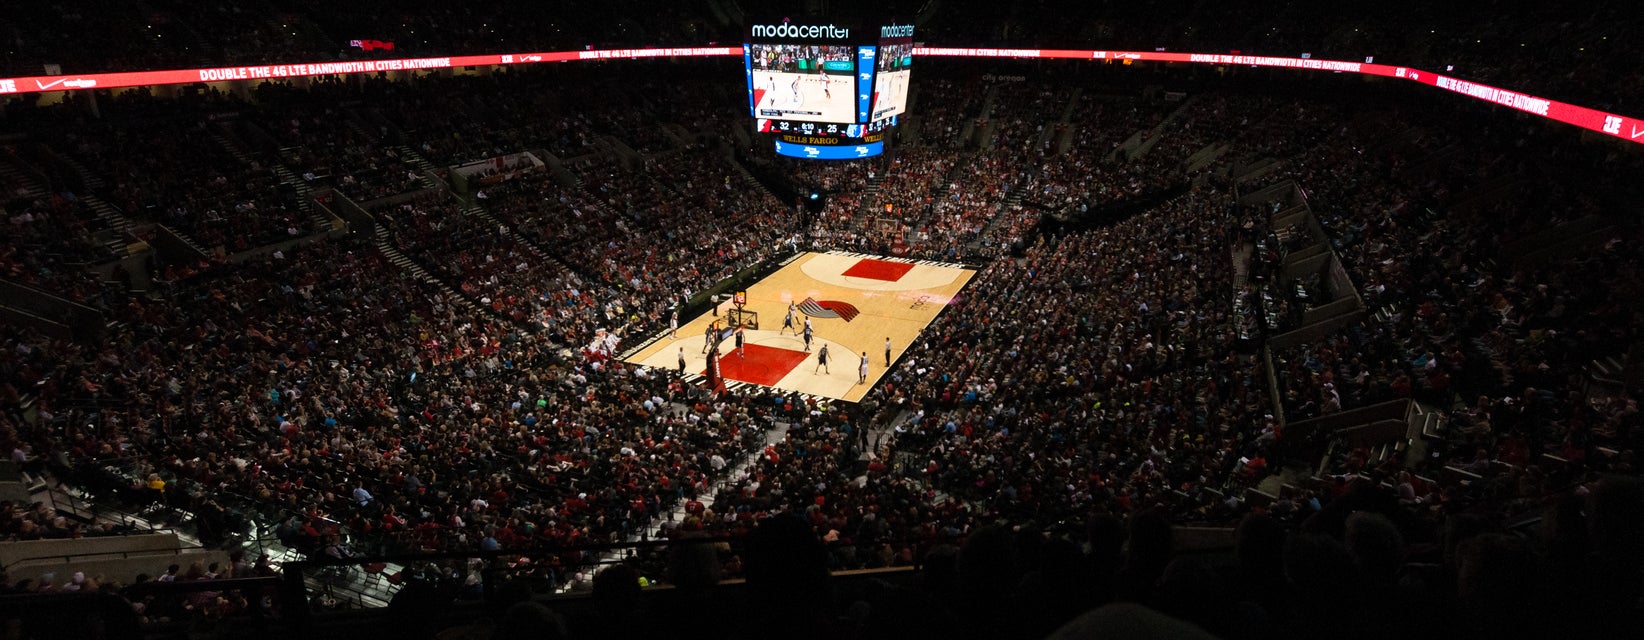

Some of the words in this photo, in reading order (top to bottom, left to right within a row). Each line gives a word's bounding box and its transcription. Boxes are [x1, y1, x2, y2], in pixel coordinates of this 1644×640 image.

[881, 22, 914, 38] modacenter
[580, 51, 598, 59] DOUBLE
[600, 50, 611, 58] THE
[200, 68, 247, 81] DOUBLE
[248, 66, 271, 78] THE
[273, 66, 287, 77] 4G
[288, 64, 307, 75] LTE
[308, 62, 364, 74] BANDWIDTH
[366, 61, 375, 70] IN
[376, 60, 402, 70] CITIES
[404, 58, 450, 69] NATIONWIDE
[1191, 54, 1219, 62] DOUBLE
[1220, 55, 1233, 63] THE
[1233, 56, 1242, 64] 4G
[1243, 56, 1255, 64] LTE
[1256, 57, 1296, 66] BANDWIDTH
[1296, 59, 1303, 67] IN
[1304, 60, 1322, 68] CITIES
[1322, 61, 1361, 72] NATIONWIDE
[982, 73, 995, 82] city
[1498, 90, 1514, 106] CITIES
[1513, 94, 1550, 116] NATIONWIDE
[783, 134, 807, 144] WELLS
[810, 136, 838, 144] FARGO
